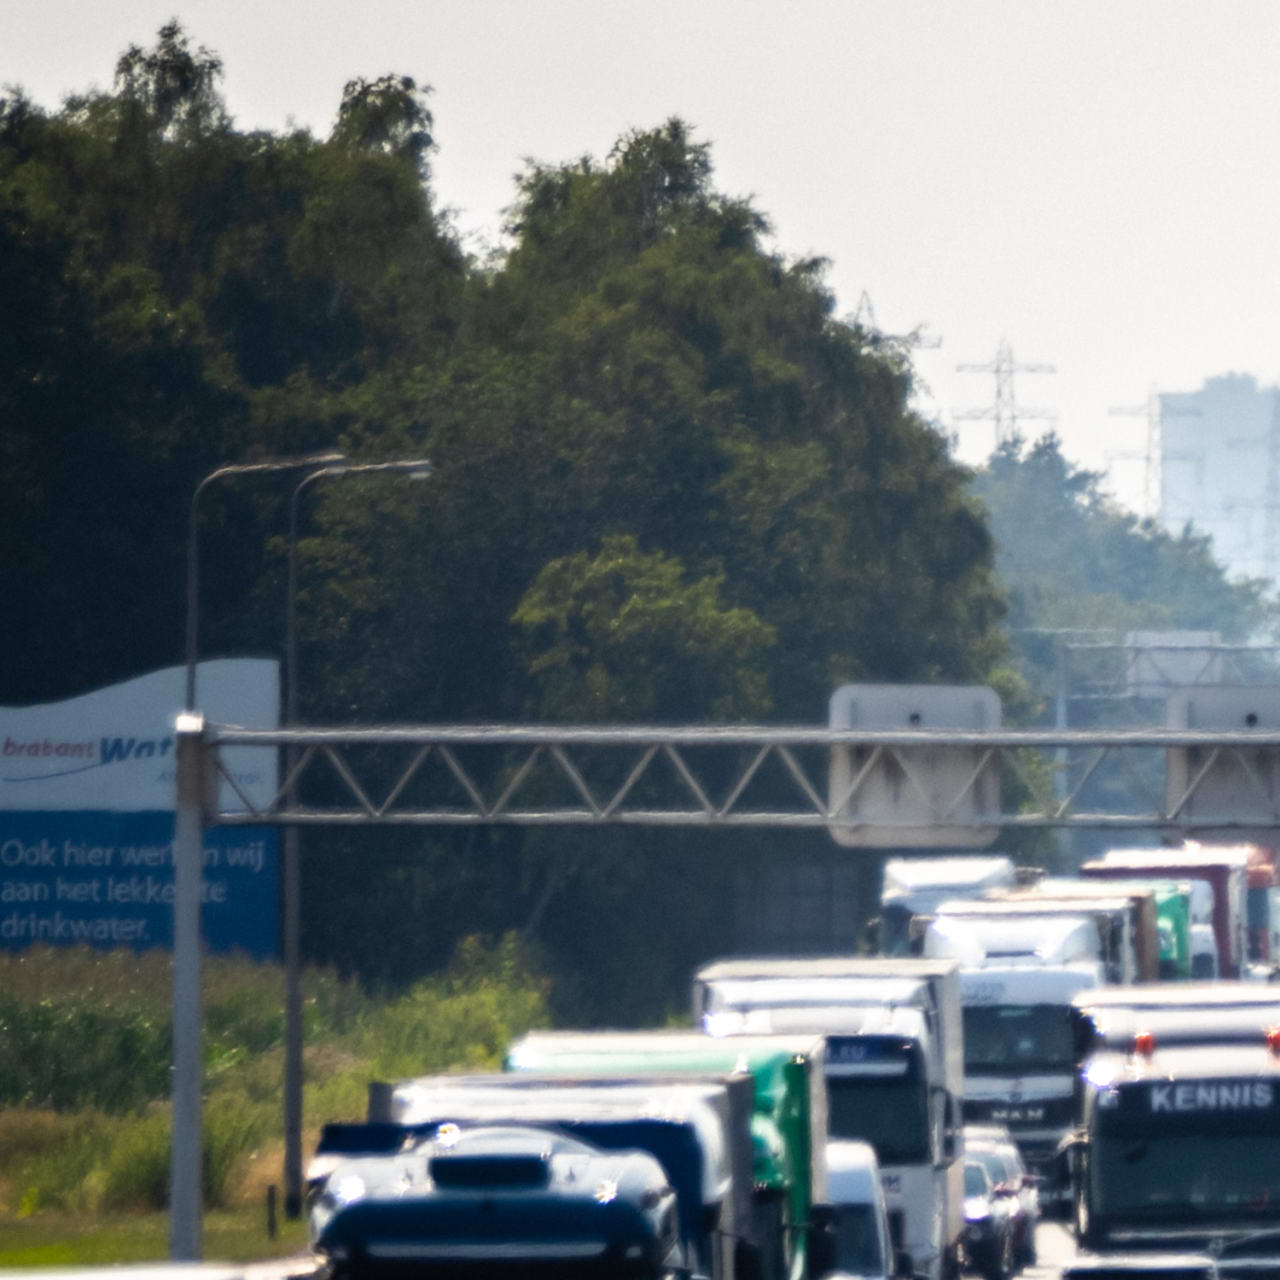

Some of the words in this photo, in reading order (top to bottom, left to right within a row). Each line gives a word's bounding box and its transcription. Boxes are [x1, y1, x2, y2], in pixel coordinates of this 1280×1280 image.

[1, 840, 56, 867] Ook
[63, 840, 115, 867] hier
[1150, 1082, 1274, 1113] KENNIS
